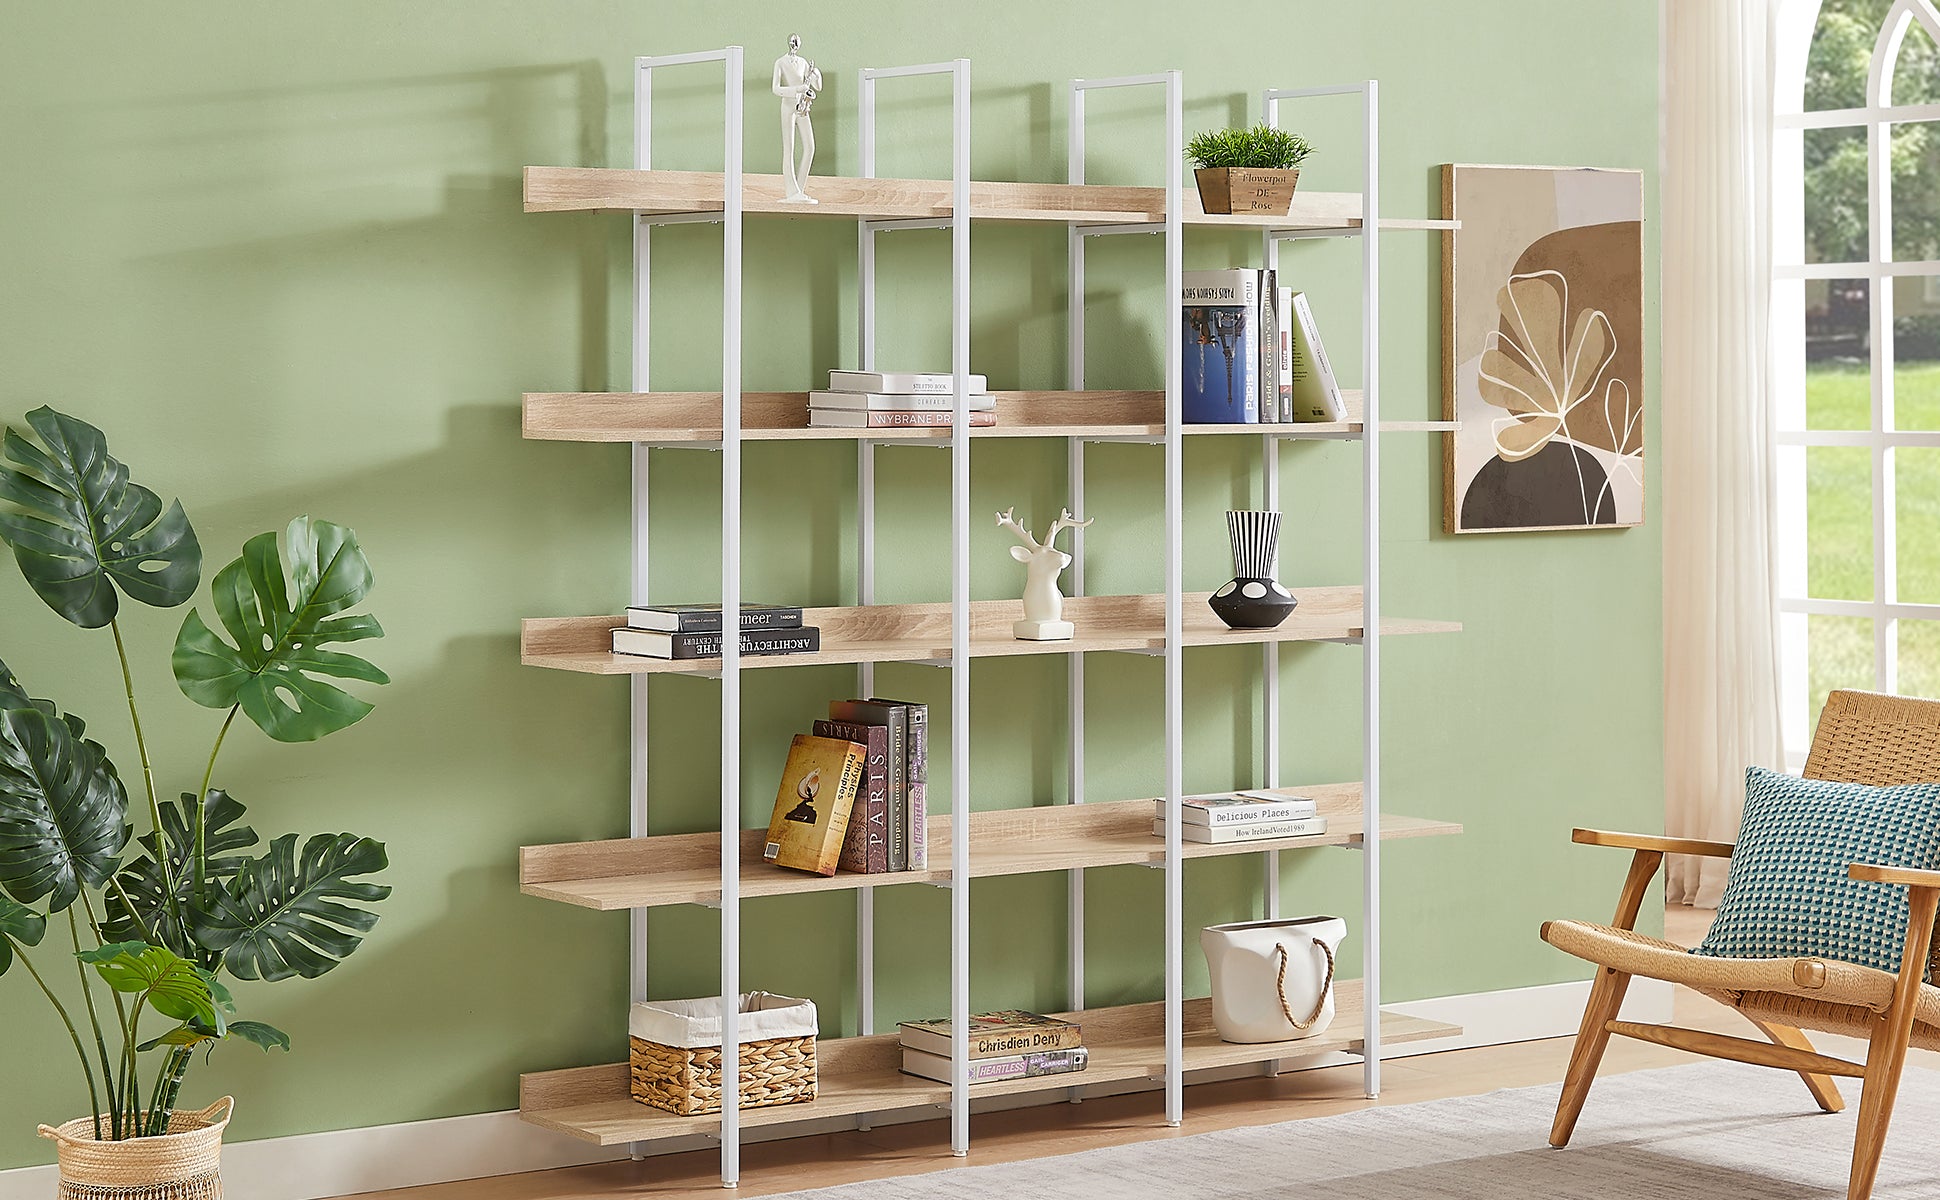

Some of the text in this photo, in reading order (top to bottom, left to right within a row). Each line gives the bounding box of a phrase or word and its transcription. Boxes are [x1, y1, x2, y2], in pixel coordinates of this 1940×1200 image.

[1242, 173, 1287, 183] Flowerpot
[1256, 188, 1270, 198] DE
[1250, 200, 1273, 210] Rose
[1197, 288, 1218, 299] FASHION
[1219, 288, 1235, 299] PARIS
[874, 413, 933, 424] WYBRANE
[682, 636, 712, 646] CENTURY
[696, 643, 718, 654] THE
[822, 723, 858, 740] PARIS
[894, 725, 902, 753] Bride
[838, 753, 856, 800] Principles
[847, 761, 863, 798] Physics
[869, 754, 885, 846] PARIS
[914, 785, 922, 843] HEARTLESS
[1216, 811, 1258, 822] Delicious
[1262, 809, 1290, 818] Places
[1235, 829, 1250, 837] How
[978, 1032, 1061, 1053] Chrisdien Deny
[979, 1062, 1026, 1076] HEARTLESS
